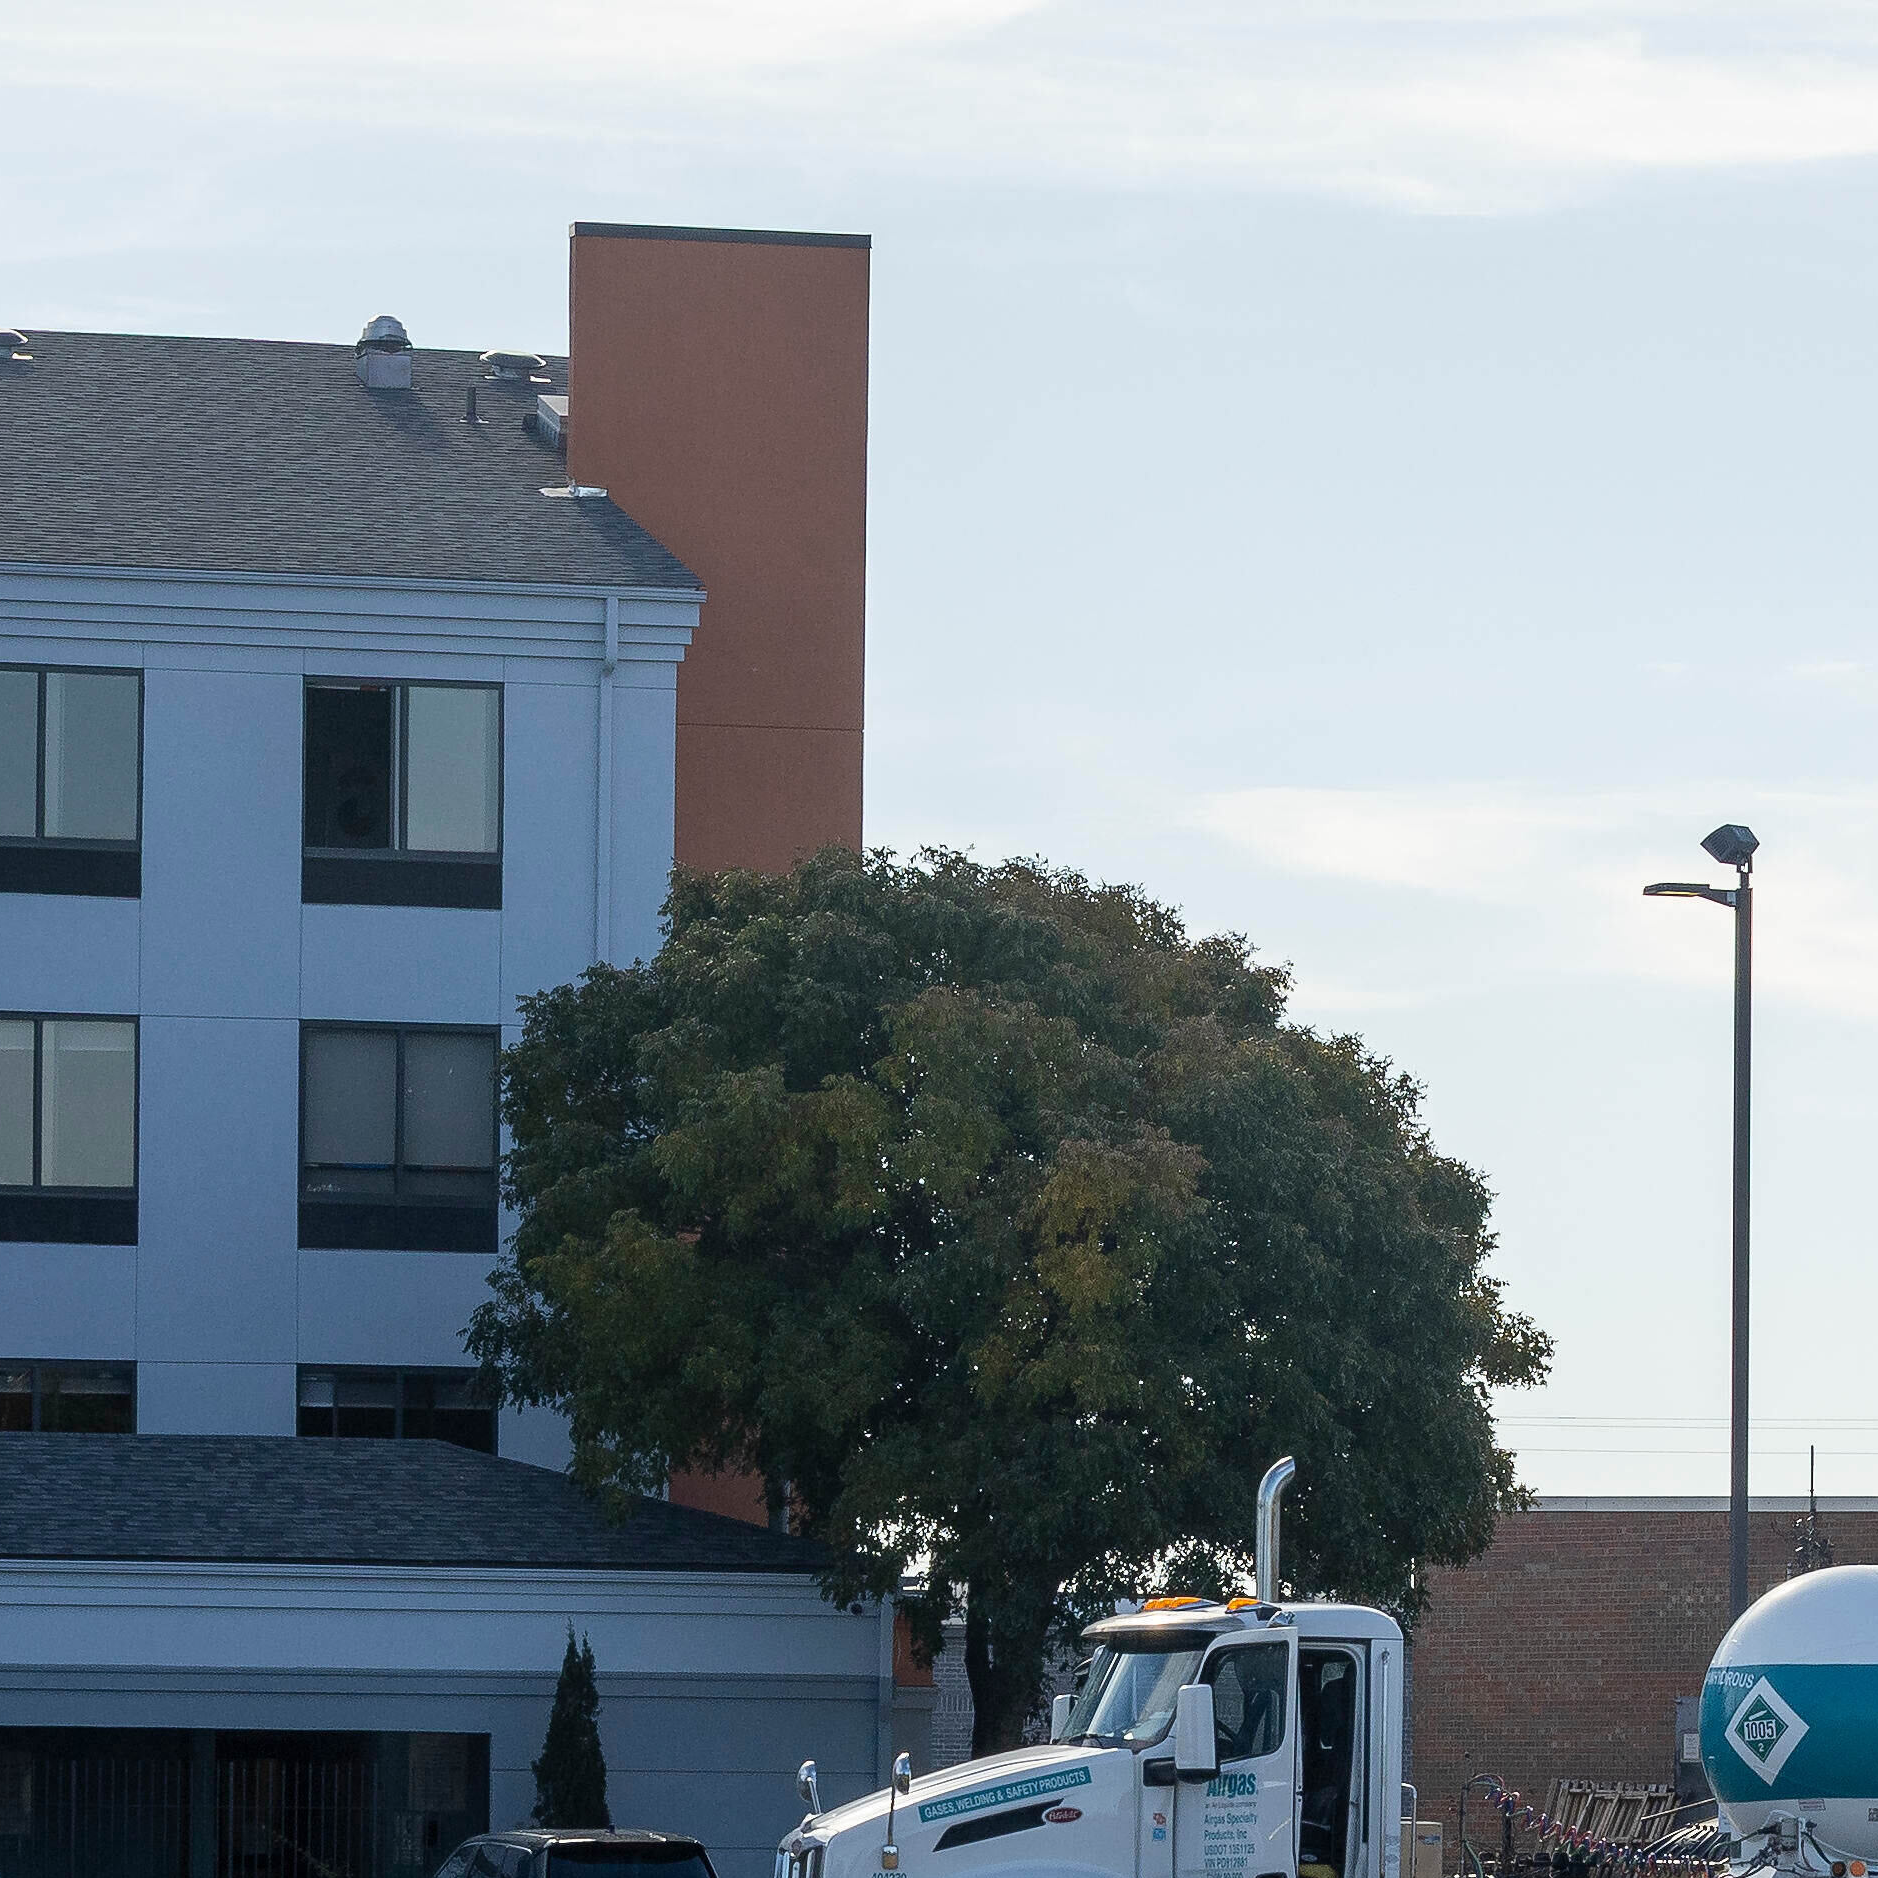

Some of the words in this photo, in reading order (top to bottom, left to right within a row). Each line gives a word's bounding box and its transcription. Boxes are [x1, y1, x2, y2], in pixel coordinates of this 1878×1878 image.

[1745, 1721, 1775, 1740] 1005
[1757, 1743, 1765, 1752] 2
[955, 1791, 996, 1810] WELDING
[996, 1789, 1005, 1801] &
[1005, 1781, 1039, 1799] SAFETY
[1038, 1770, 1086, 1791] PRODUCTS
